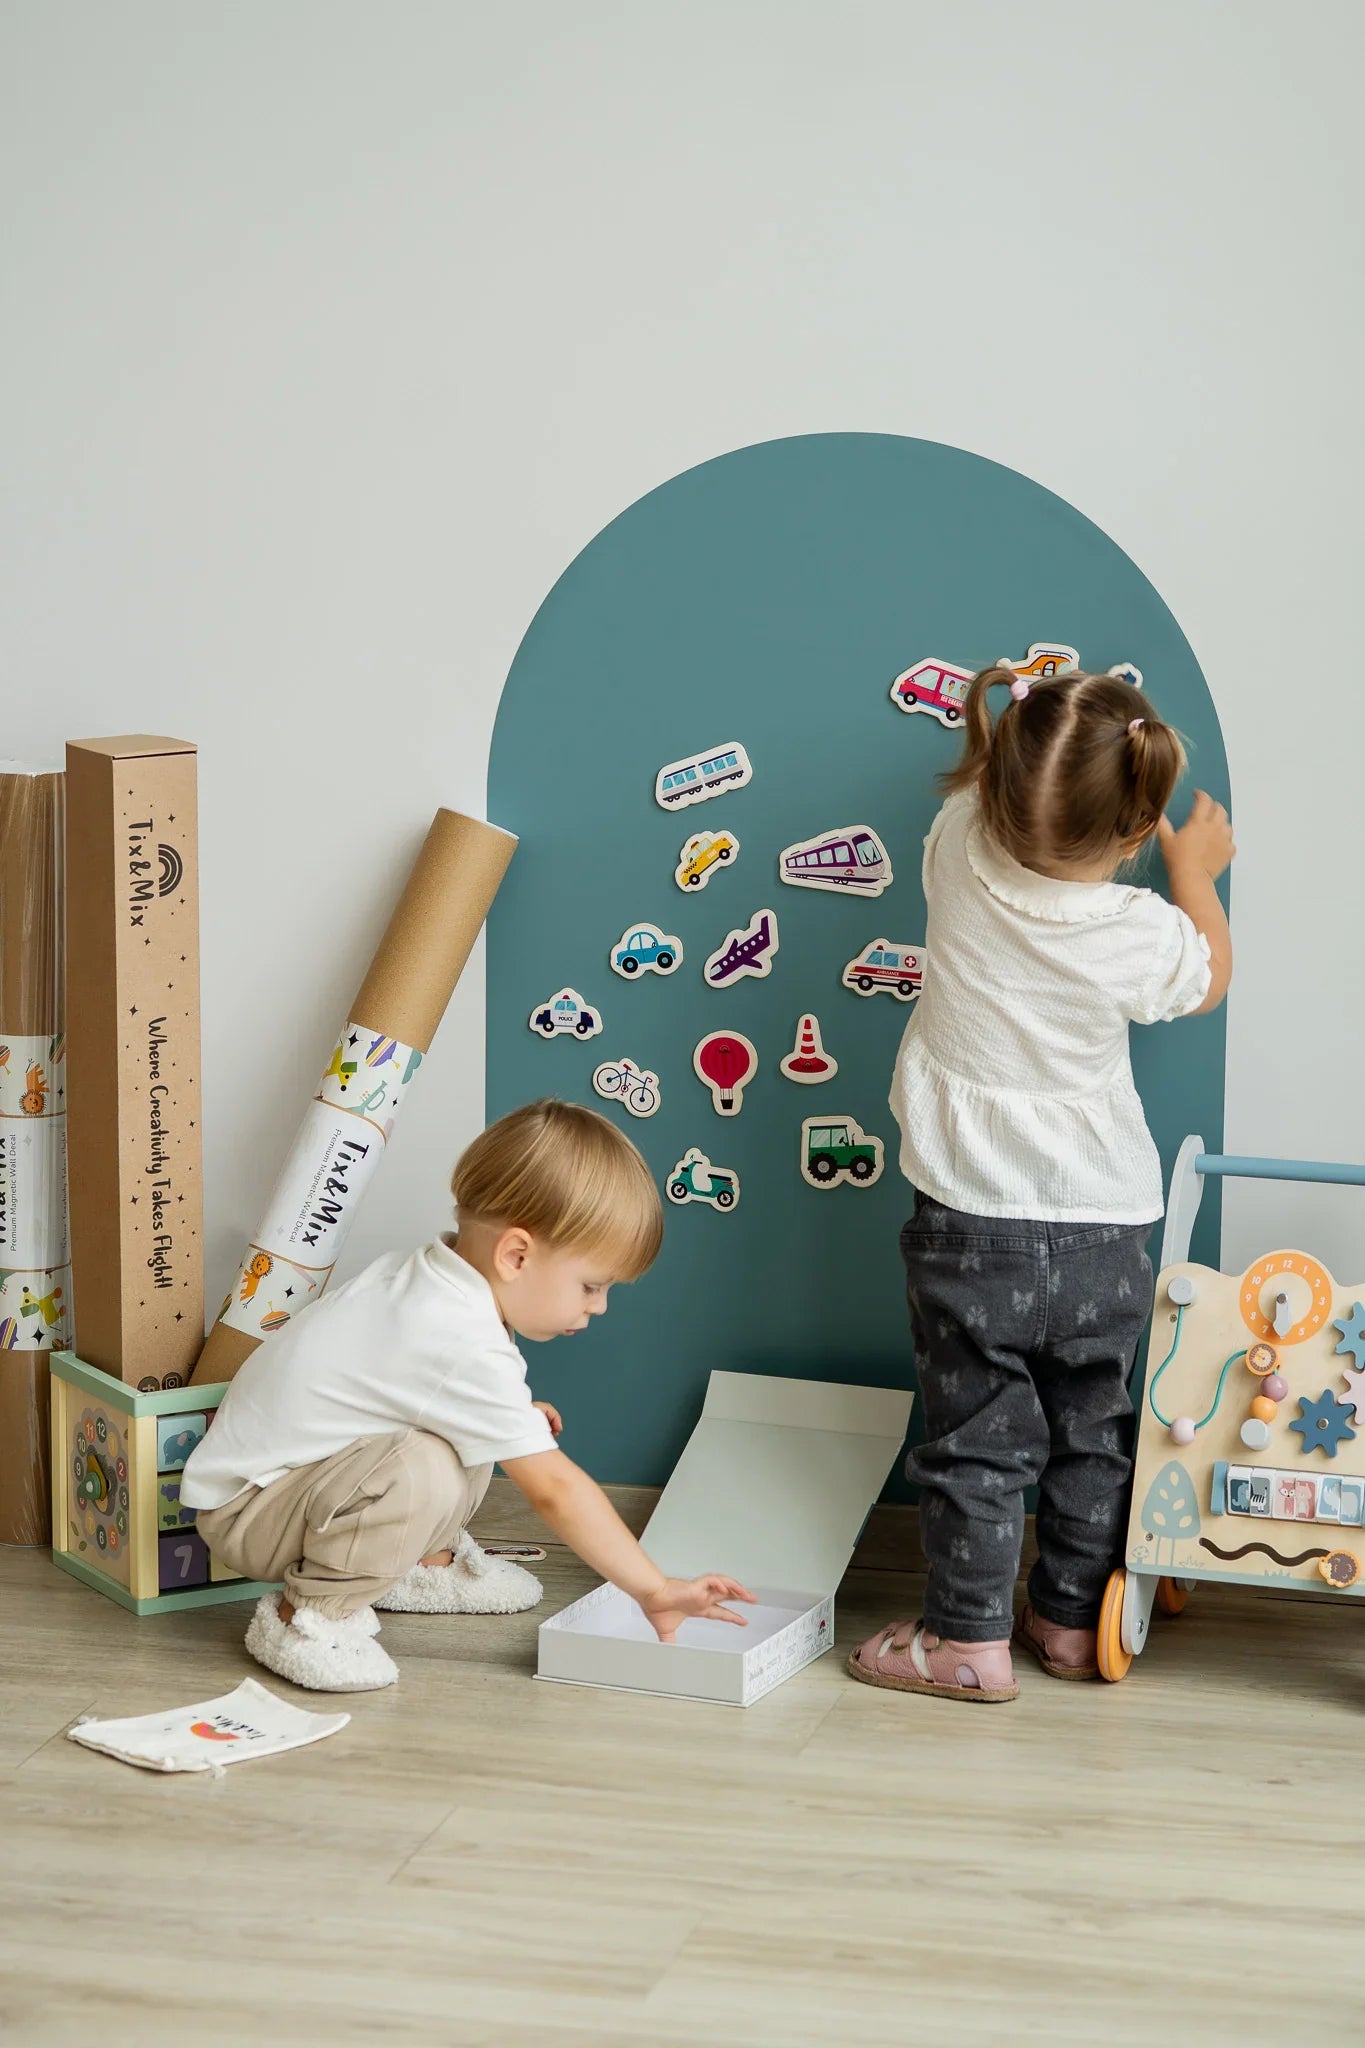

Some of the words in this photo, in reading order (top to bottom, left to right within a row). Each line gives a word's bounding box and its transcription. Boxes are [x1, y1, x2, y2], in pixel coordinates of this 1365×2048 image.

[128, 818, 154, 927] Tix&Mix
[148, 1016, 168, 1080] Where
[145, 1085, 171, 1174] Creativity
[322, 1128, 342, 1163] Premium
[9, 1158, 17, 1177] Wall
[307, 1164, 327, 1199] Magnetic
[9, 1180, 18, 1215] Magnetic
[302, 1140, 369, 1247] Tix&Mix
[151, 1178, 171, 1231] Takes
[300, 1201, 312, 1220] Wall
[9, 1217, 17, 1252] Premium
[289, 1221, 303, 1243] Decal
[147, 1235, 173, 1289] Flight!
[1265, 1263, 1275, 1273] 11
[1282, 1259, 1294, 1269] 12
[1302, 1265, 1309, 1275] 1
[1251, 1276, 1261, 1285] 10
[1314, 1278, 1321, 1288] 2
[1245, 1293, 1252, 1302] 9
[1319, 1296, 1326, 1306] 3
[1249, 1311, 1257, 1320] 8
[1312, 1314, 1319, 1324] 4
[1262, 1324, 1269, 1334] 7
[1298, 1327, 1305, 1336] 5
[86, 1423, 94, 1439] 11
[96, 1422, 106, 1438] 12
[78, 1437, 86, 1453] 10
[76, 1462, 81, 1476] 9
[118, 1462, 124, 1476] 2
[122, 1491, 127, 1506] 3
[118, 1516, 123, 1530] 4
[99, 1531, 104, 1545] 6
[111, 1531, 116, 1545] 5
[174, 1545, 193, 1578] 7
